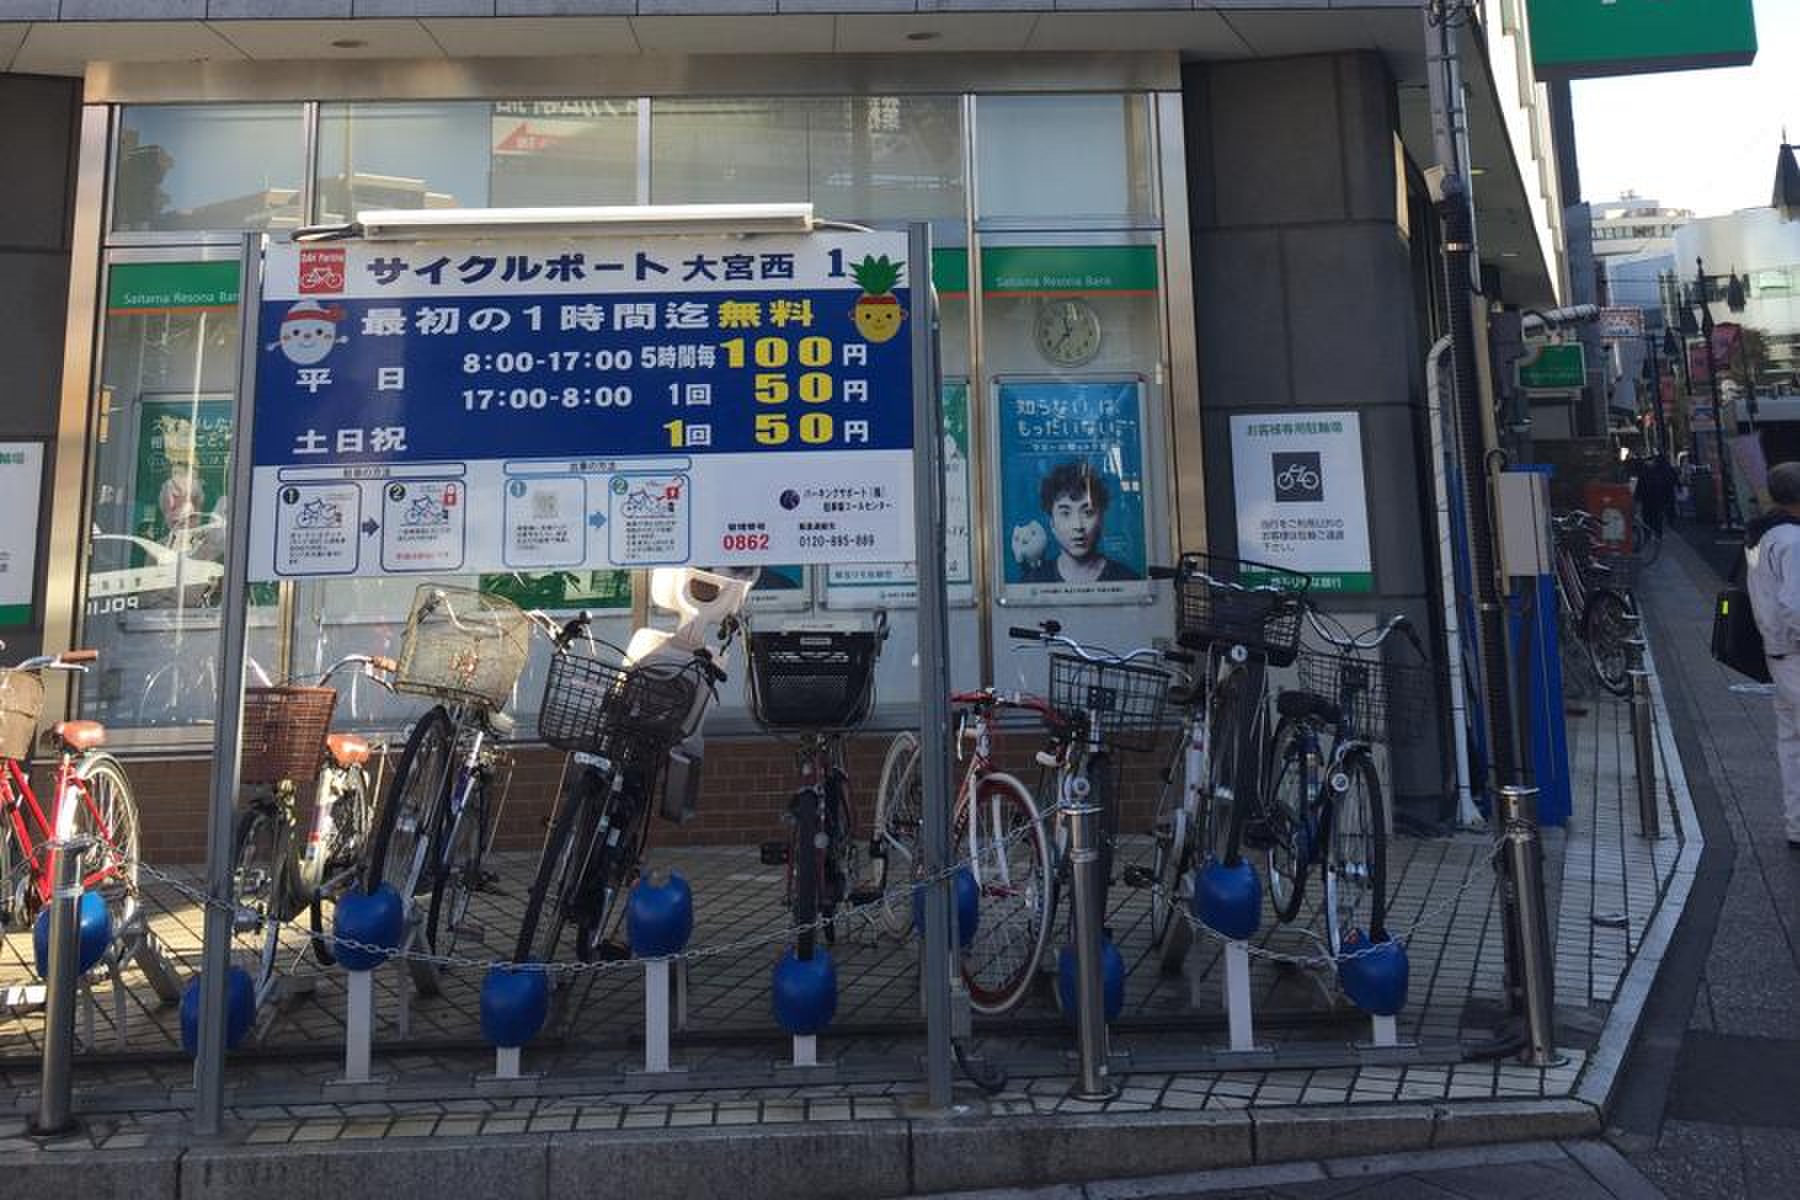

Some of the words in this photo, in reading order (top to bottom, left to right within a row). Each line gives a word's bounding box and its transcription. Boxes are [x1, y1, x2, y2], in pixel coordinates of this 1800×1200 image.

[366, 252, 670, 286] サイクルポート
[682, 254, 795, 282] 大宮西
[463, 350, 633, 374] 8:00-17:00
[462, 386, 633, 411] 17:00-8:00
[292, 426, 408, 455] 土日祝
[722, 533, 769, 551] 0862
